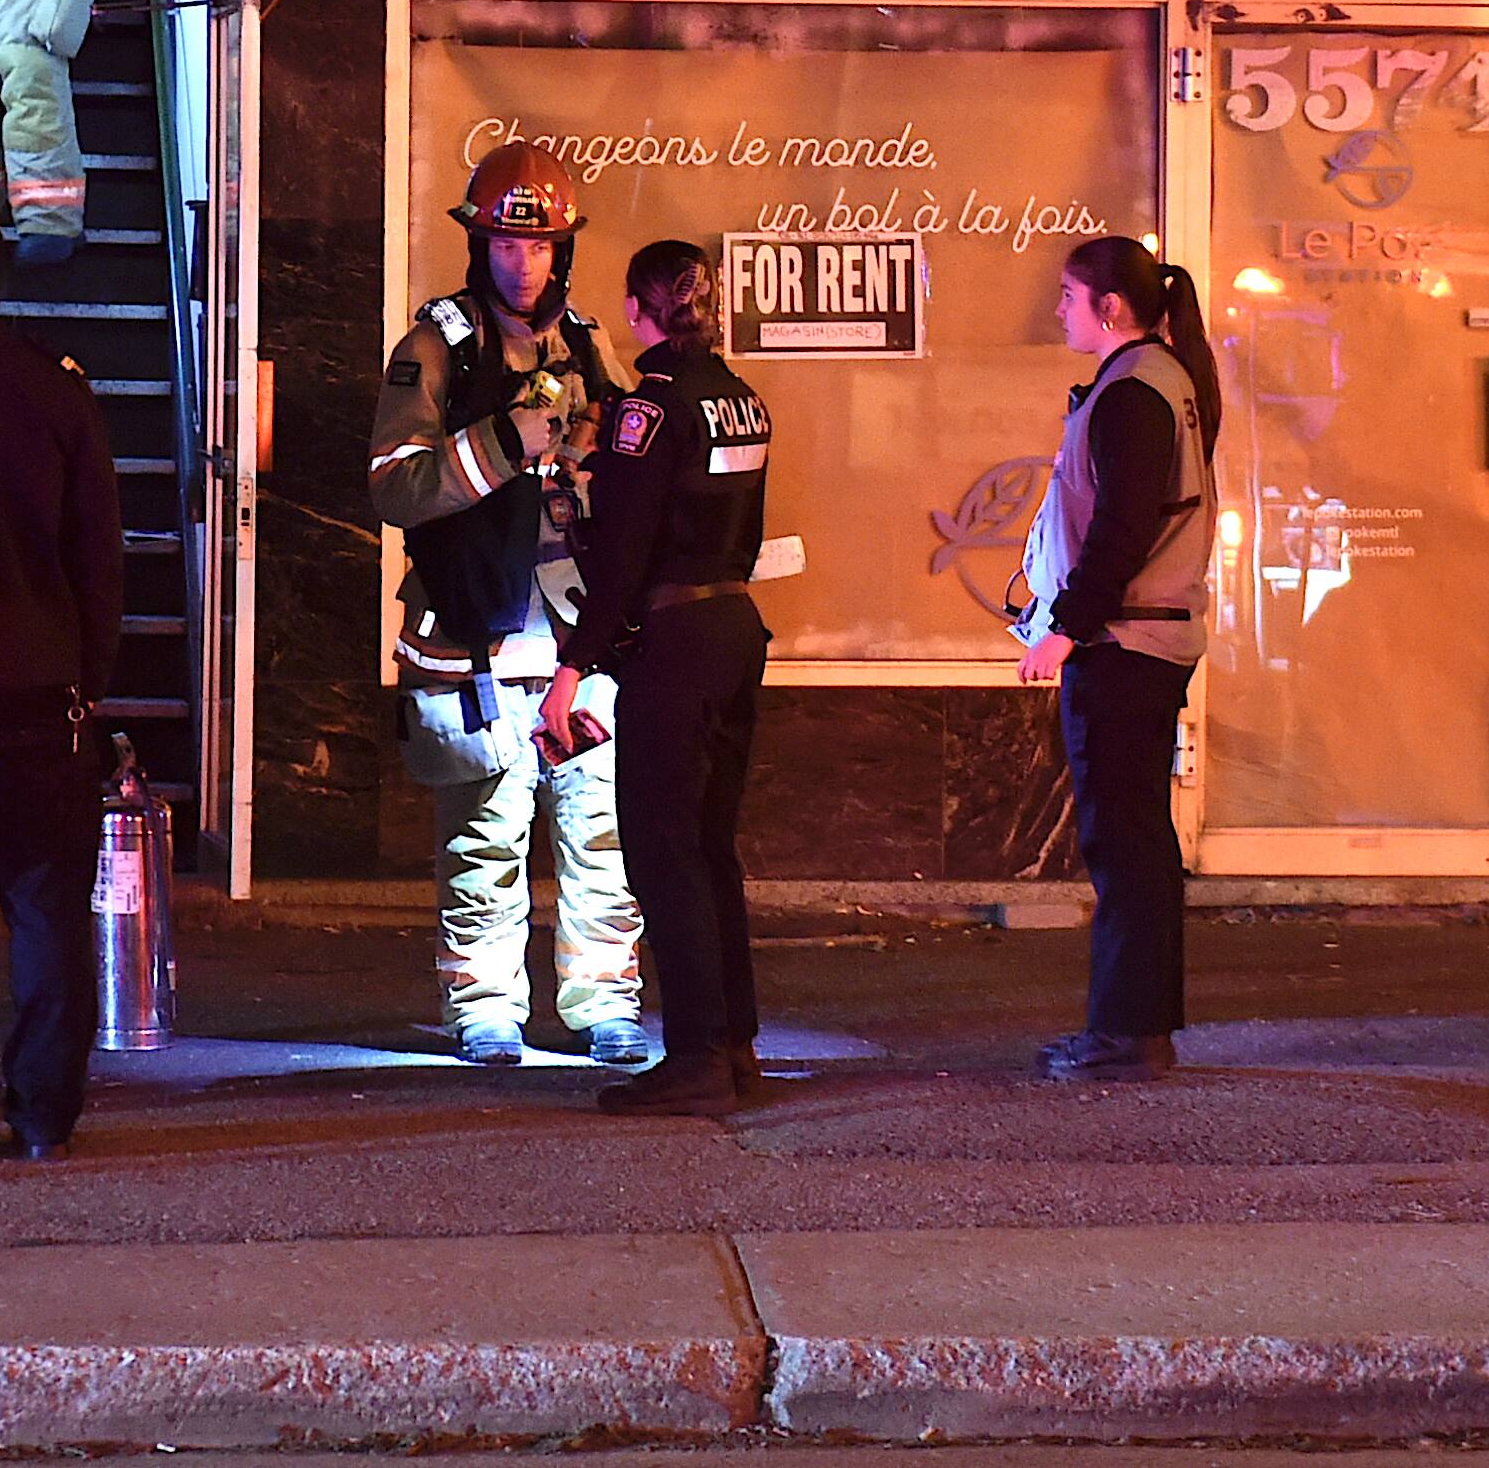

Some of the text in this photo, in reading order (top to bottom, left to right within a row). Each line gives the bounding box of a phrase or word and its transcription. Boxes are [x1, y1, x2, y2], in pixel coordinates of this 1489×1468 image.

[728, 120, 771, 167] le
[757, 187, 1108, 253] un bol à la fois.
[1281, 221, 1330, 261] Le
[732, 244, 912, 314] FOR RENT
